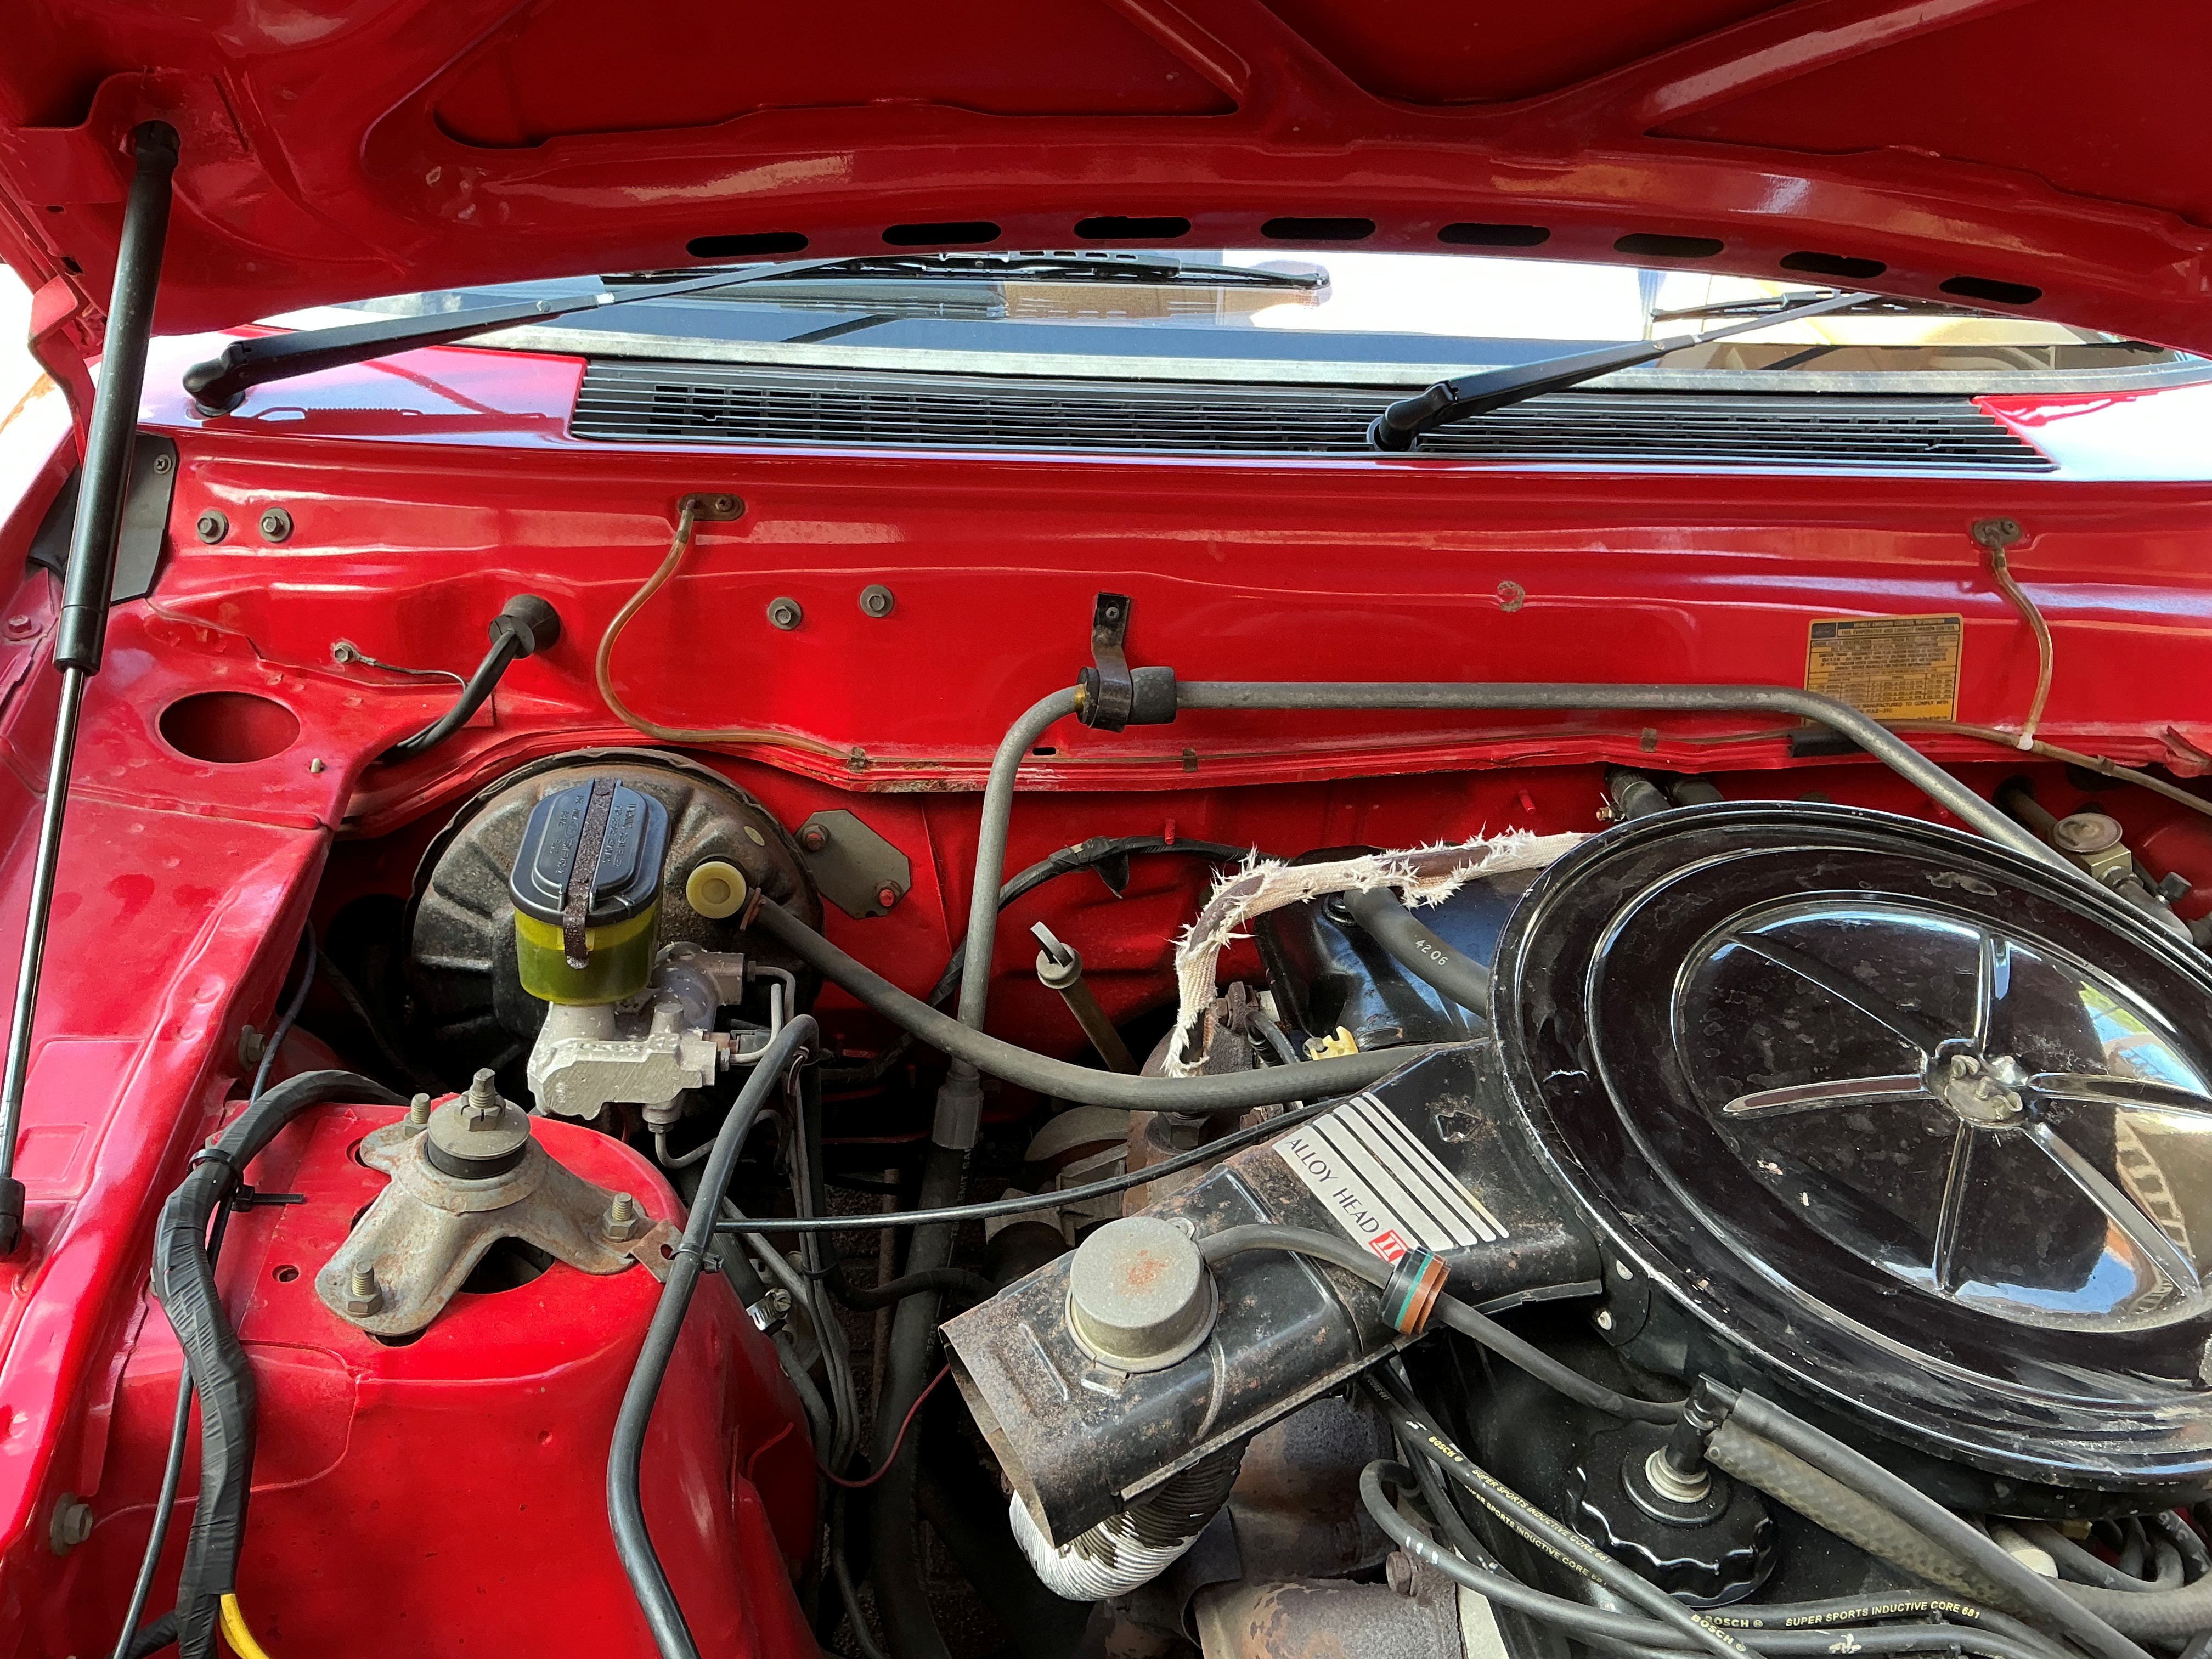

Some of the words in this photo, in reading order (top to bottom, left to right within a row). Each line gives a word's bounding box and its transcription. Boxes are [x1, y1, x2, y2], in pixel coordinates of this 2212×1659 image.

[1414, 939, 1448, 966] 4206
[1286, 1138, 1338, 1183] ALLOY
[1333, 1187, 1381, 1233] HEAD
[1428, 1436, 1456, 1458] BOSCH
[1472, 1469, 1499, 1488] SUPER
[1497, 1486, 1529, 1508] SPORTS
[1527, 1506, 1572, 1537] INDUCTIVE
[1570, 1536, 1597, 1554] CORE
[1486, 1502, 1516, 1526] SPORTS
[1516, 1525, 1561, 1559] INDUCTIVE
[1562, 1557, 1590, 1576] CORE
[1691, 1613, 1734, 1645] BOSCH
[1705, 1615, 1749, 1628] BOSCH
[1785, 1614, 1822, 1627] SUPER
[1825, 1607, 1869, 1623] SPORTS
[1872, 1601, 1928, 1616] INDUCTIVE
[1930, 1600, 1960, 1612] CORE
[1961, 1606, 1980, 1619] 681
